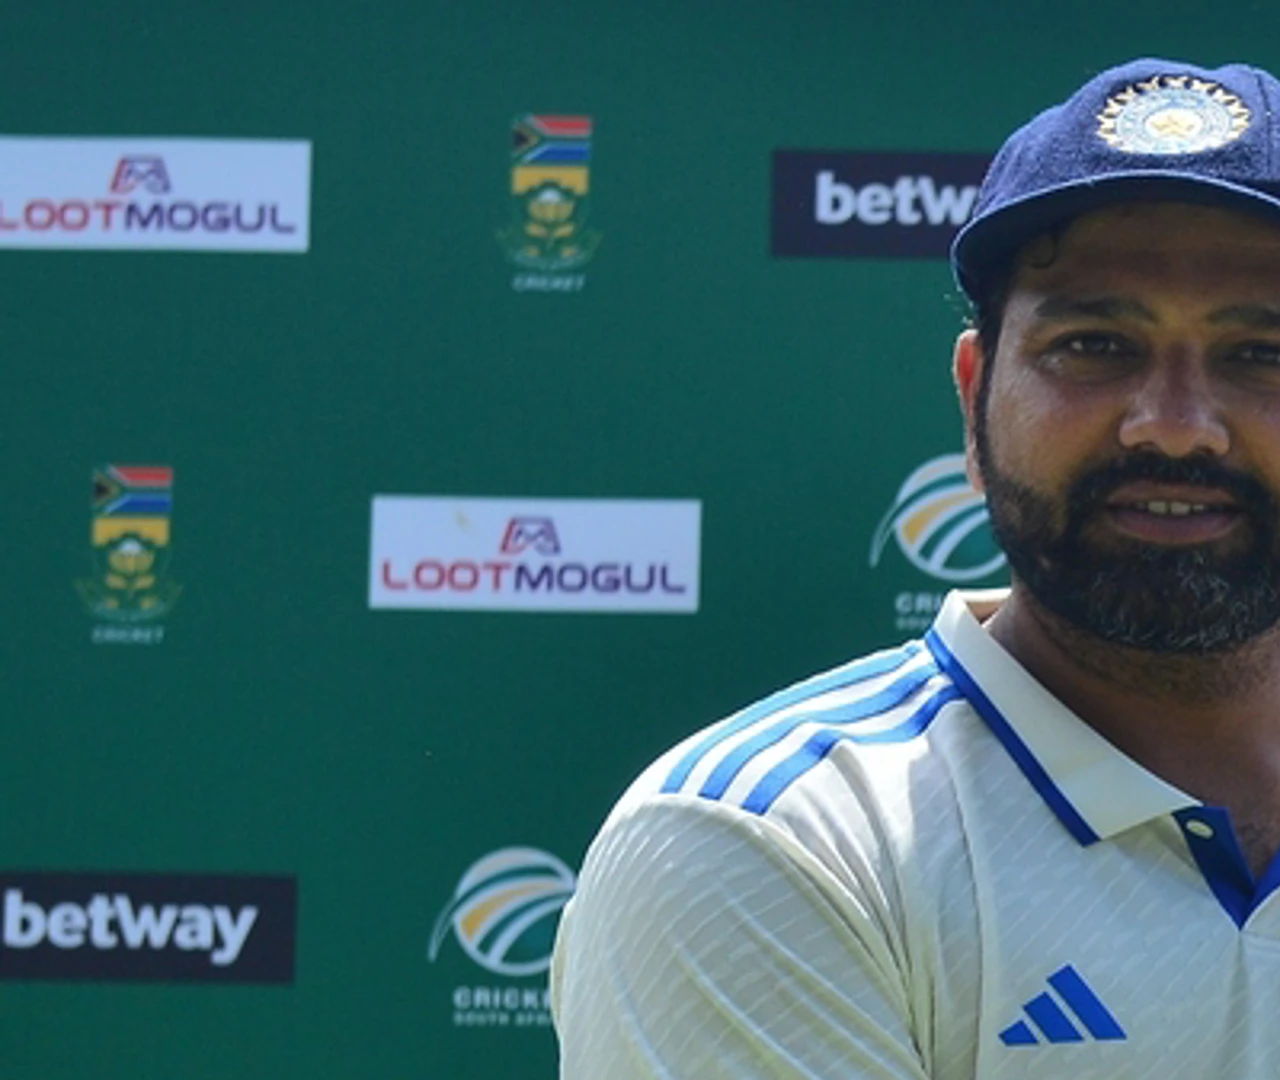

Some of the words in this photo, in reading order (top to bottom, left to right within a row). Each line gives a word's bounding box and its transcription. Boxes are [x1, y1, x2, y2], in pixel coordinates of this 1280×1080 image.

[815, 171, 977, 224] betw
[382, 561, 686, 594] LOOTMOGUL
[3, 889, 258, 965] betway
[453, 986, 550, 1009] CRICK
